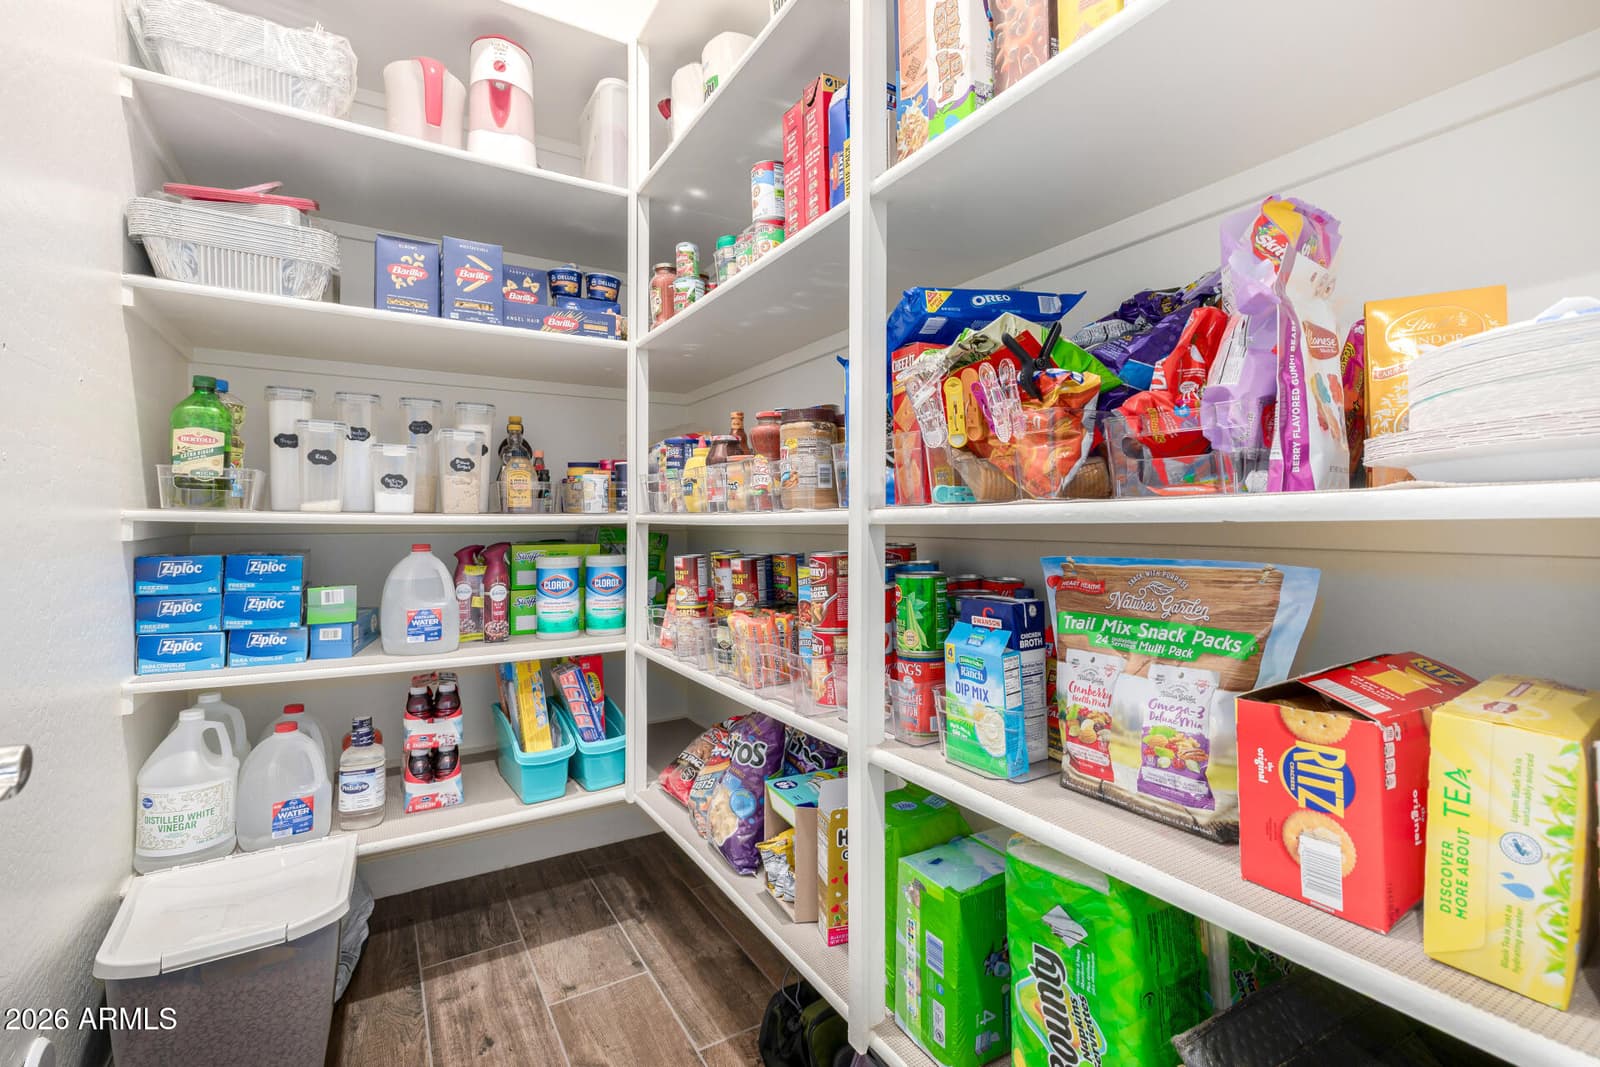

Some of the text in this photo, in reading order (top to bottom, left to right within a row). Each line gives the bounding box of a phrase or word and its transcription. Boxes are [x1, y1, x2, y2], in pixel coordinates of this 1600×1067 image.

[392, 266, 425, 278] Barilla
[459, 270, 489, 281] Barilla
[557, 274, 578, 282] DELUXE
[508, 292, 536, 303] Barilla
[972, 294, 1011, 306] OREO
[547, 318, 576, 329] Barilla
[1289, 354, 1300, 385] GUMMI
[1291, 387, 1300, 439] FLAVORED
[180, 435, 217, 443] BERTOLLI
[1291, 442, 1301, 474] BERRY
[160, 561, 203, 578] Ziploc
[250, 560, 288, 574] Ziploc
[543, 581, 571, 590] CLOROX
[594, 577, 621, 588] CLOROX
[1145, 569, 1161, 578] WITH
[1161, 571, 1190, 591] PURPOSE
[248, 597, 287, 612] Ziploc
[514, 596, 537, 606] Swiff
[1159, 596, 1211, 621] Garden
[160, 601, 203, 617] Ziploc
[973, 617, 1001, 627] SWANSON
[250, 633, 288, 648] Ziploc
[1020, 631, 1042, 640] CHICKEN
[1064, 615, 1243, 652] Trail Mix Snack Packs
[161, 640, 203, 655] Ziploc
[1019, 638, 1043, 649] BROTH
[1095, 633, 1108, 645] 24
[1138, 640, 1165, 655] Multi
[1169, 646, 1195, 659] Pack
[948, 647, 953, 657] 4
[960, 667, 984, 681] Ranch
[1409, 657, 1465, 686] RITZ
[955, 682, 990, 703] DIP MIX
[1068, 680, 1112, 708] Cranberry
[1148, 698, 1206, 721] Omega-3
[1149, 711, 1178, 725] Deluxe
[1254, 747, 1269, 784] original
[1292, 740, 1348, 819] RITZ
[1443, 767, 1473, 817] TEA
[144, 807, 216, 825] DISTILLED WHITE
[277, 808, 310, 819] WATER
[1411, 789, 1423, 846] original
[157, 821, 197, 833] VINEGAR
[1439, 840, 1454, 914] DISCOVER
[1456, 826, 1471, 920] MORE ABOUT
[1071, 996, 1093, 1062] Napkins
[1080, 993, 1102, 1067] erviettes
